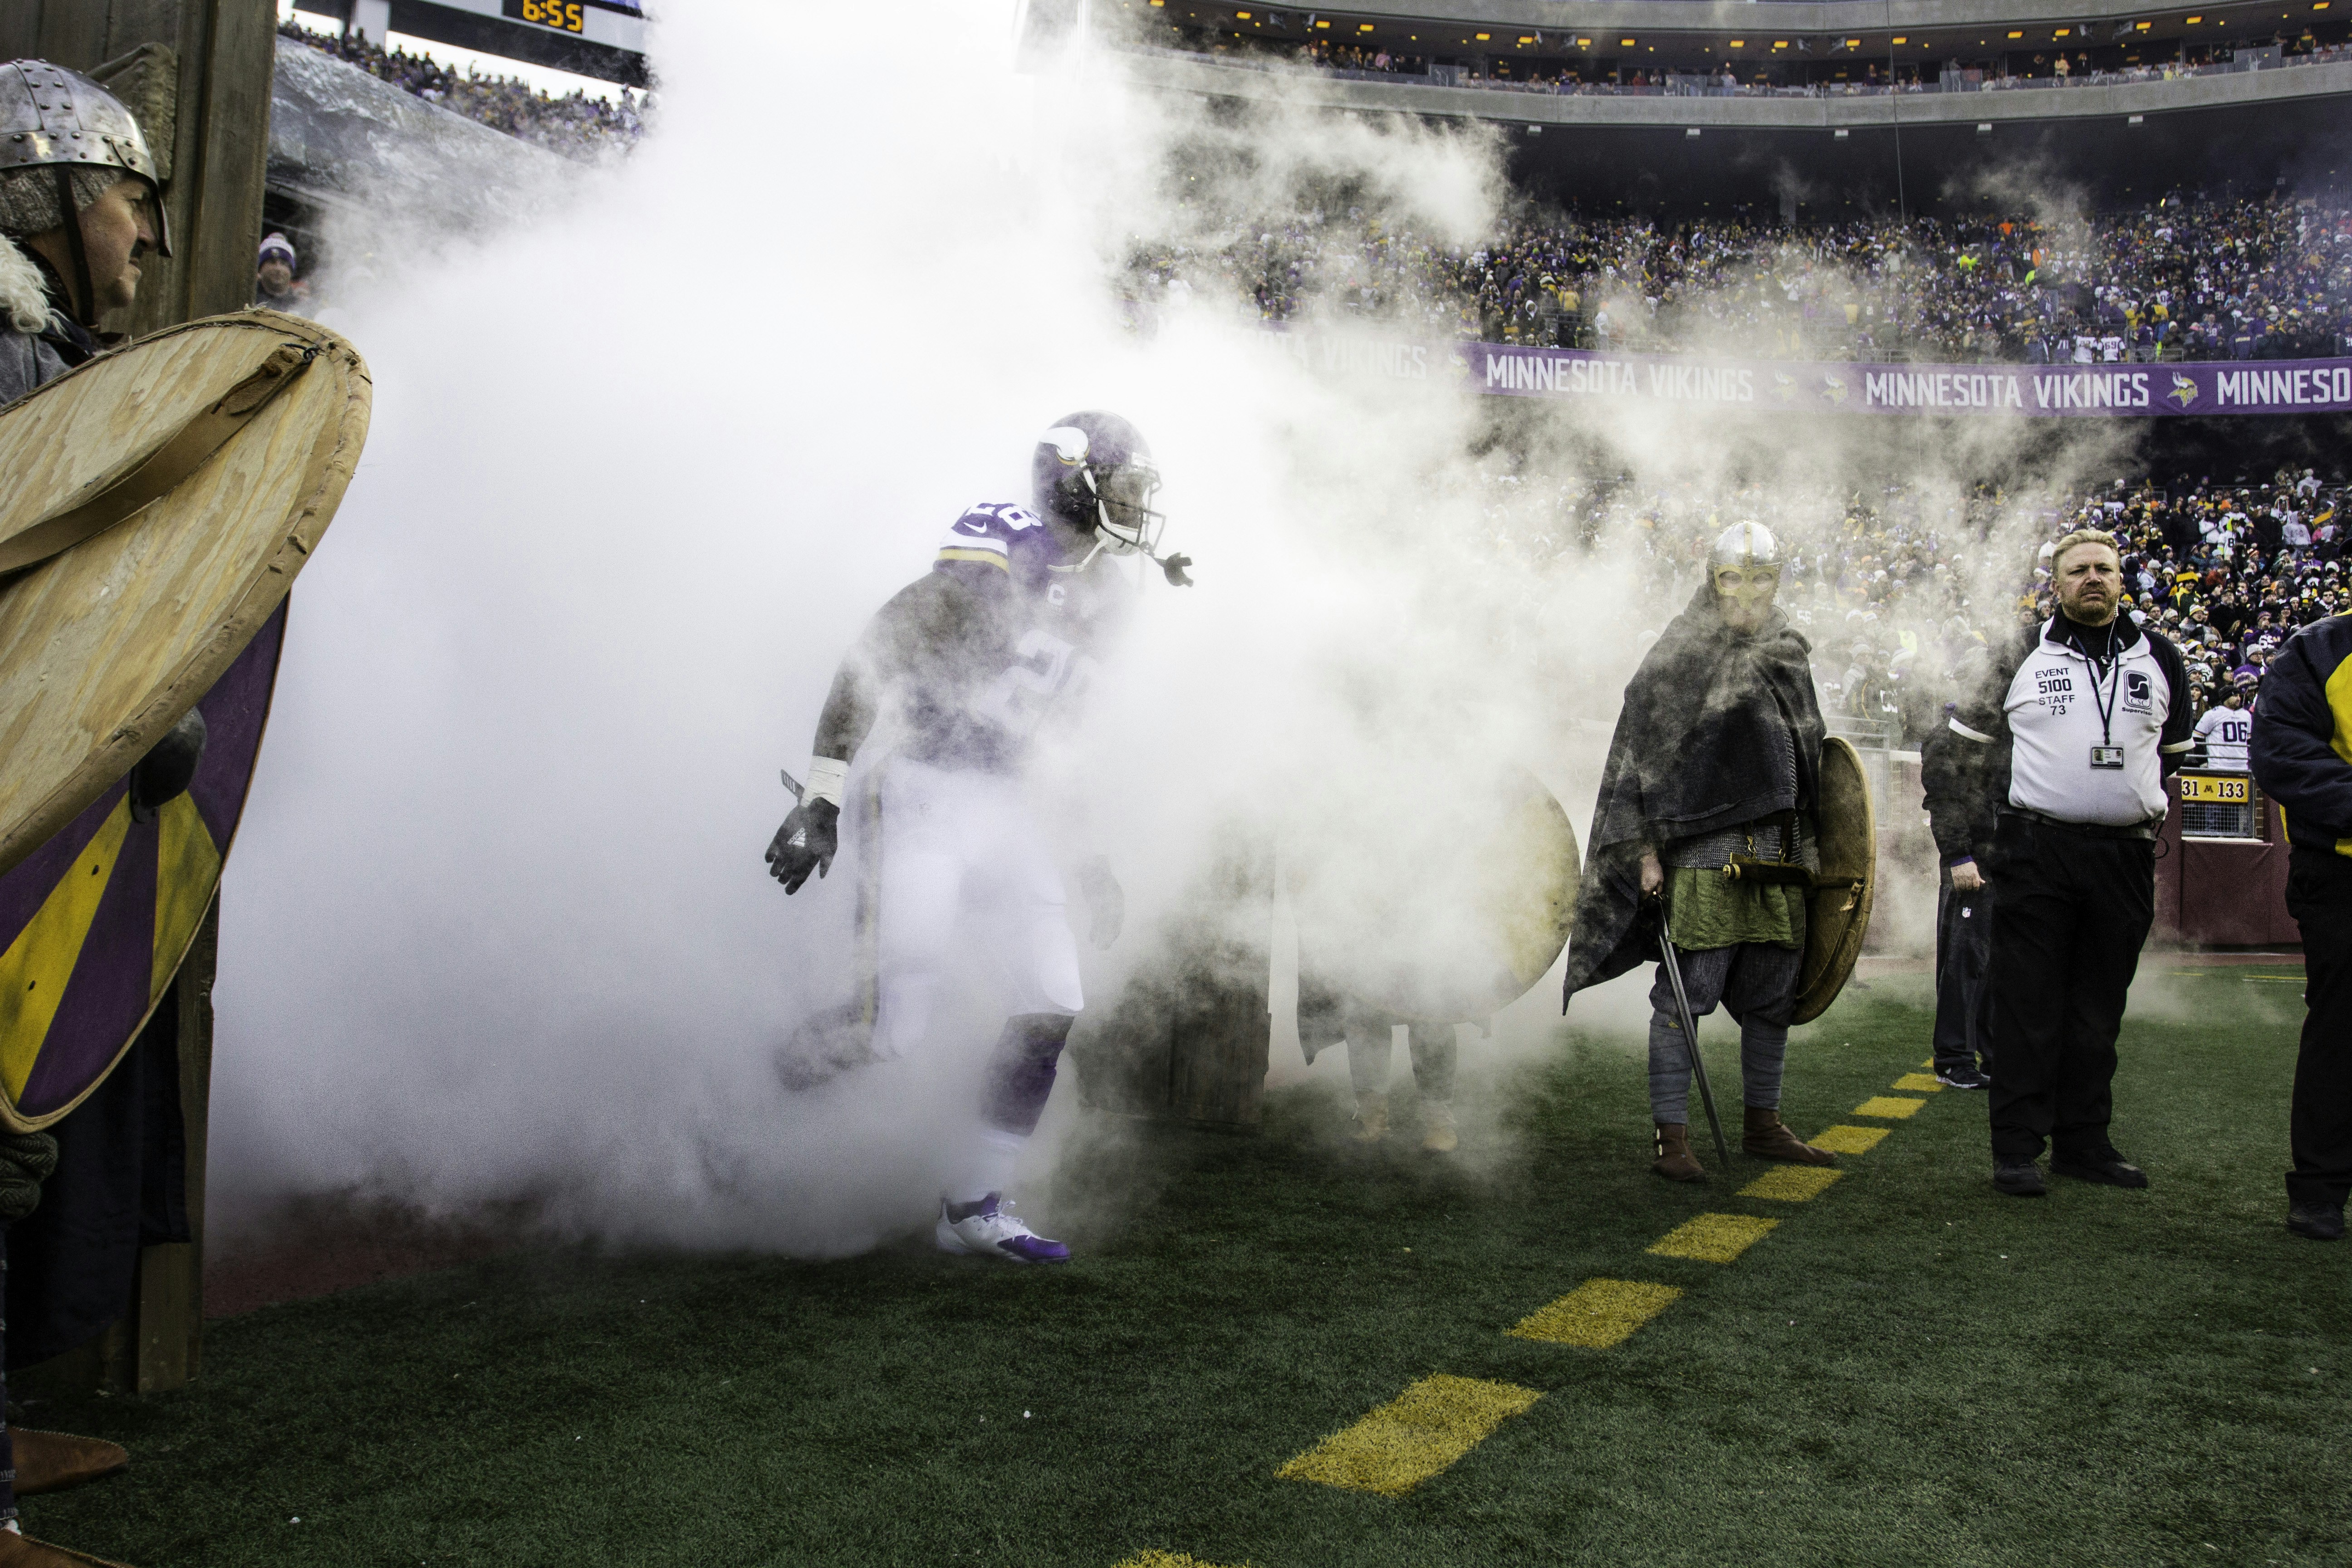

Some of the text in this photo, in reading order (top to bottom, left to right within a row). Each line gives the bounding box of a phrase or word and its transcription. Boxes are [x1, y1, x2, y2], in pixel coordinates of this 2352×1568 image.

[523, 0, 583, 31] 6:55
[1487, 353, 1753, 401] MINNESOTA VIKINGS
[1866, 372, 2149, 408] MINNESOTA VIKINGS
[2217, 368, 2351, 405] MINNESO
[2035, 667, 2069, 679] EVENT
[2038, 679, 2072, 694] 5100
[2038, 695, 2075, 706] STAFF
[2131, 698, 2147, 707] CSC
[2050, 705, 2066, 715] 73
[2223, 721, 2247, 742] 06
[2218, 782, 2244, 799] 133
[787, 827, 805, 845] adidas
